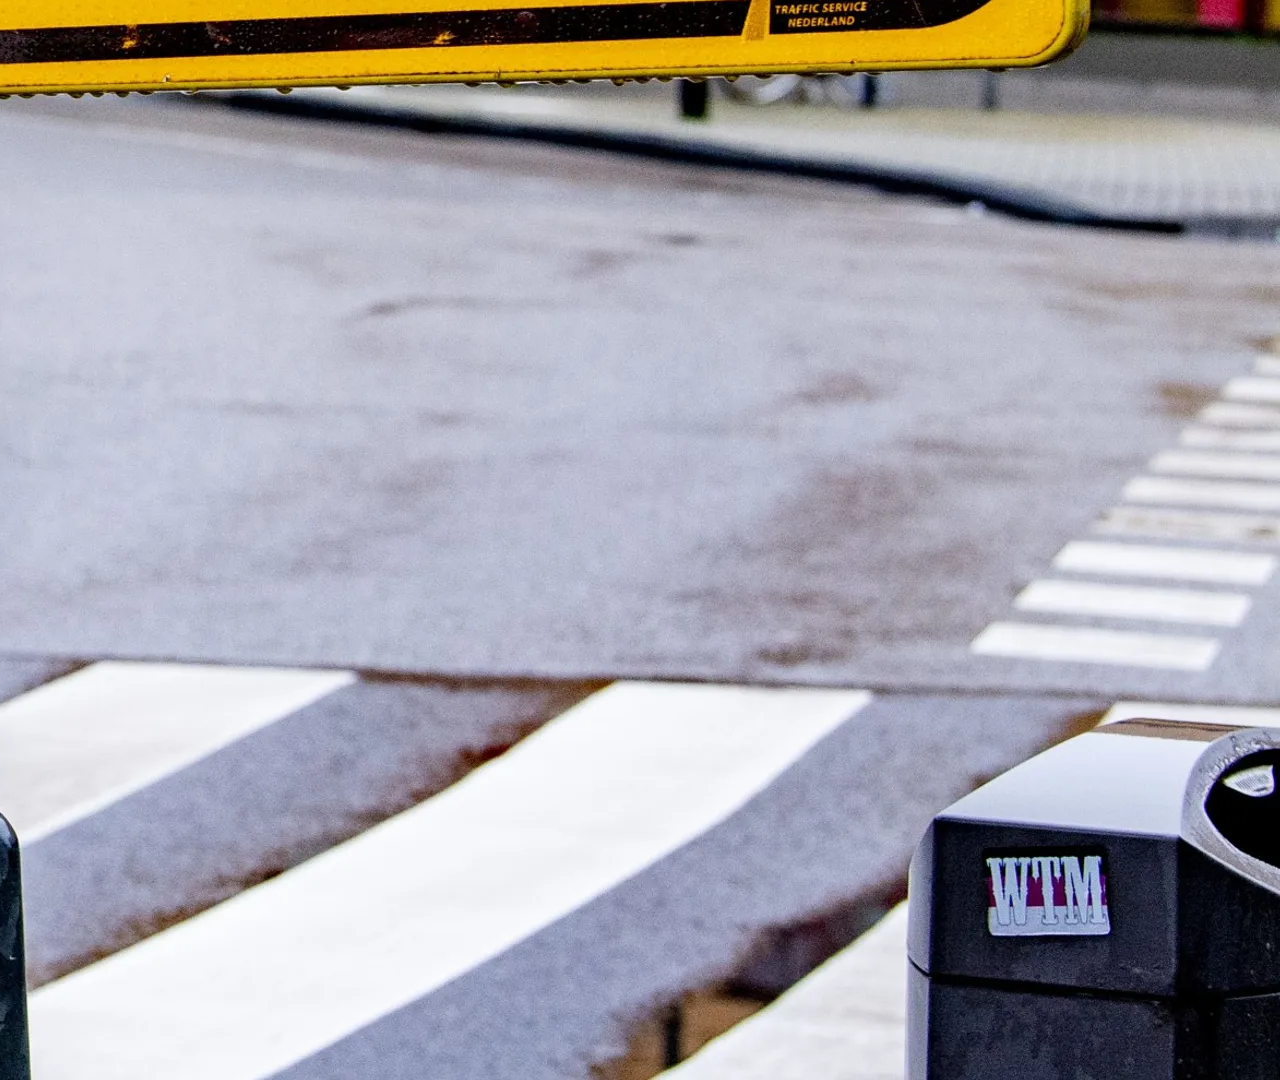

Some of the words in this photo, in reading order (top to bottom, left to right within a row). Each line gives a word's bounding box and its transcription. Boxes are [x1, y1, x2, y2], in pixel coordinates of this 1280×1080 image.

[774, 2, 819, 15] TRAFFIC
[821, 1, 868, 13] SERVICE
[787, 16, 855, 28] NEDERLAND
[986, 855, 1107, 926] WTM
